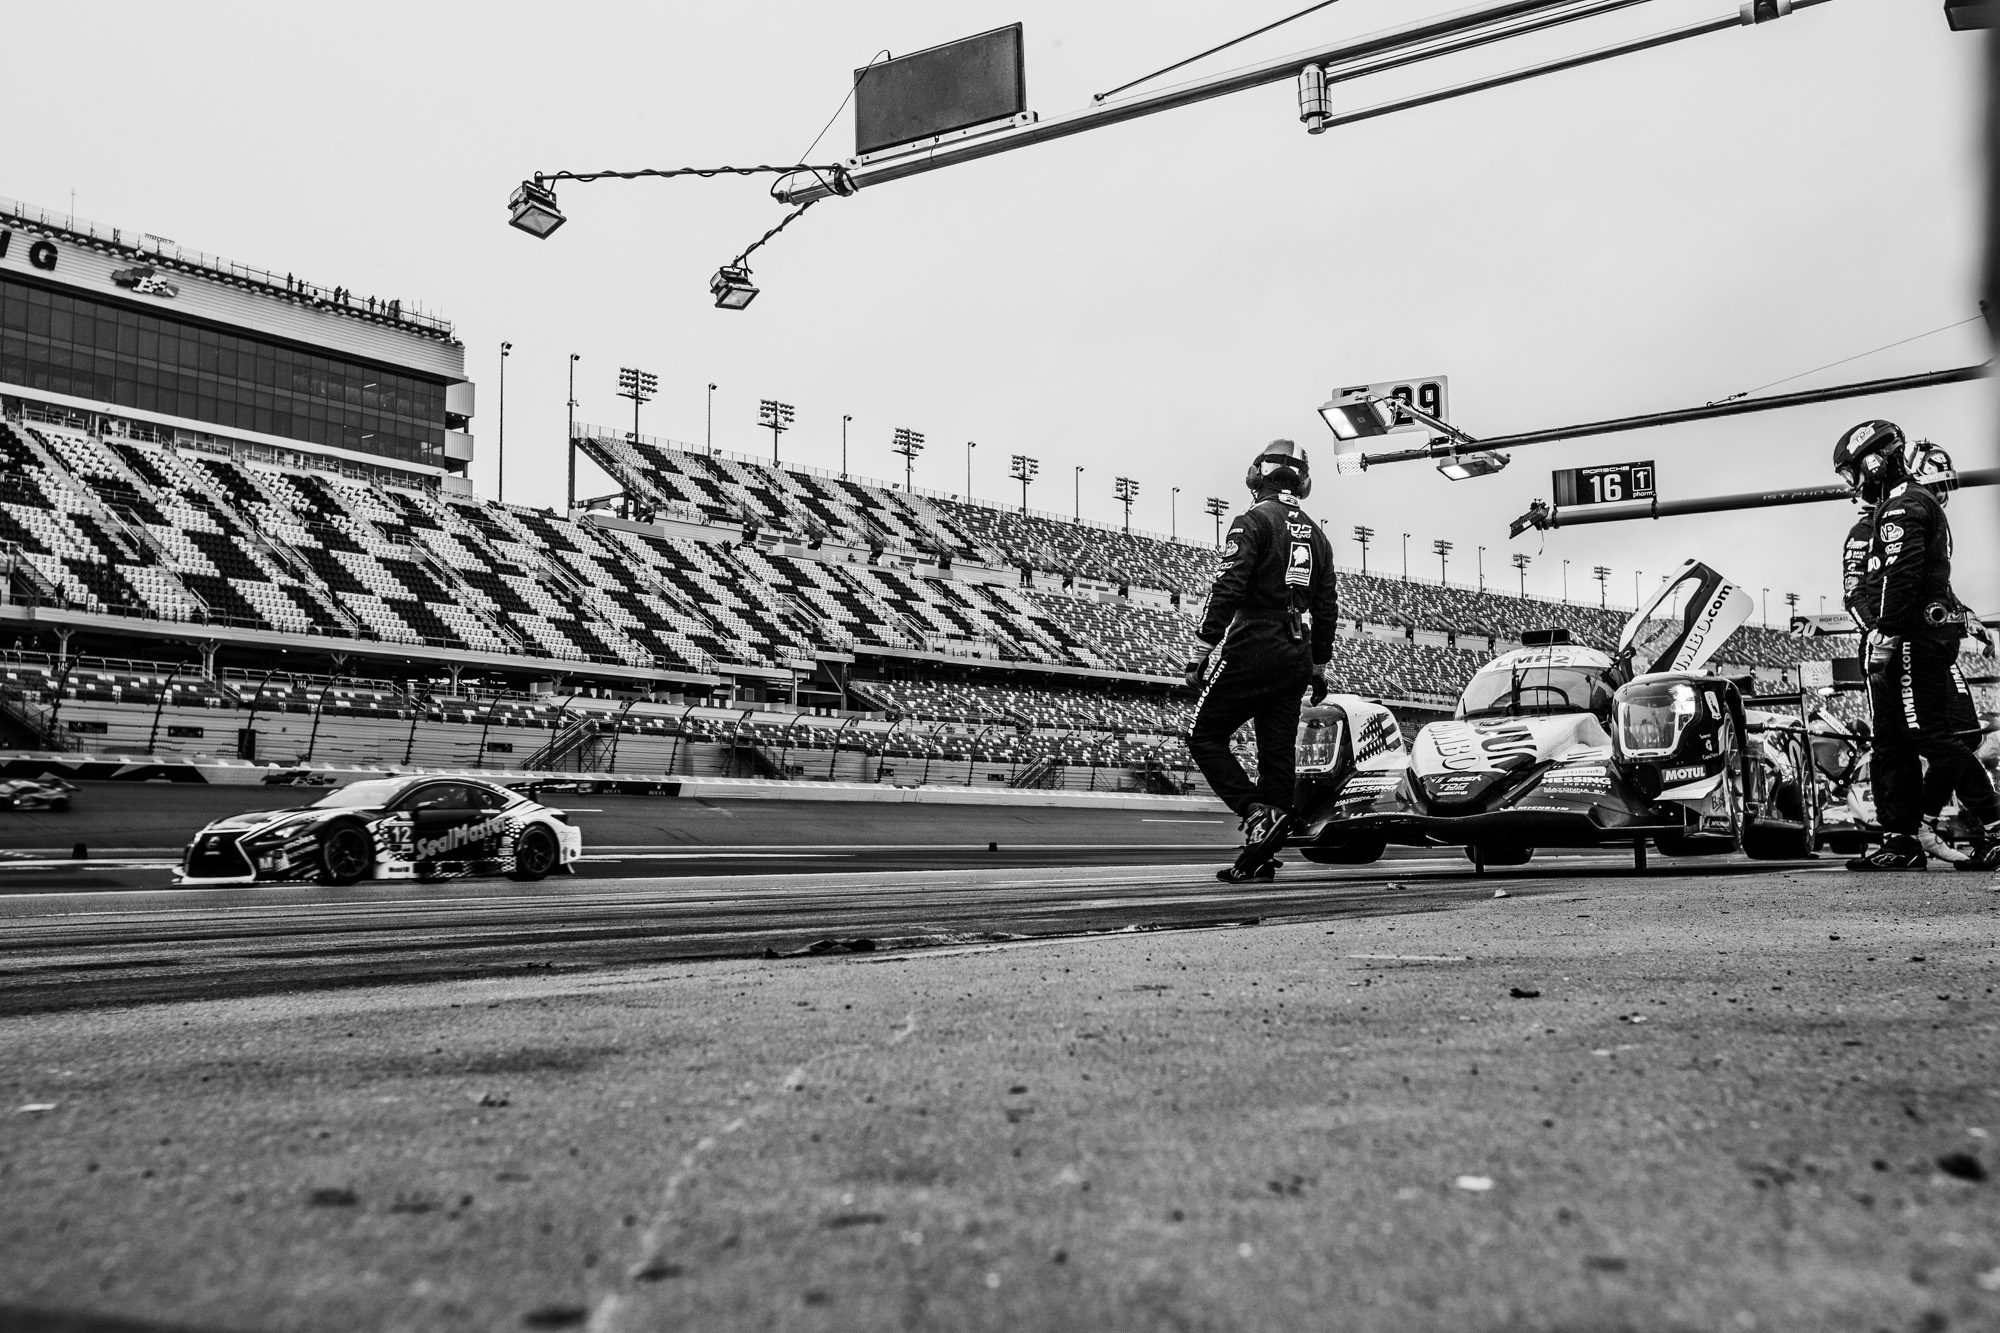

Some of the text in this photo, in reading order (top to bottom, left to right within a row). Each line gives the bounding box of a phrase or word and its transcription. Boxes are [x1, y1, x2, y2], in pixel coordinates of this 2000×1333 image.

[1582, 465, 1630, 475] PORSCHE
[1590, 473, 1622, 503] 16
[1673, 584, 1733, 672] UMBO.com
[1790, 621, 1818, 637] 20
[1495, 655, 1570, 669] LMP2
[1901, 641, 1920, 730] JUMBO.com
[1541, 776, 1612, 785] HESSING
[1665, 767, 1706, 780] MOTUL
[1340, 784, 1398, 796] HESSING
[392, 826, 411, 842] 12
[416, 817, 506, 861] SealMaster
